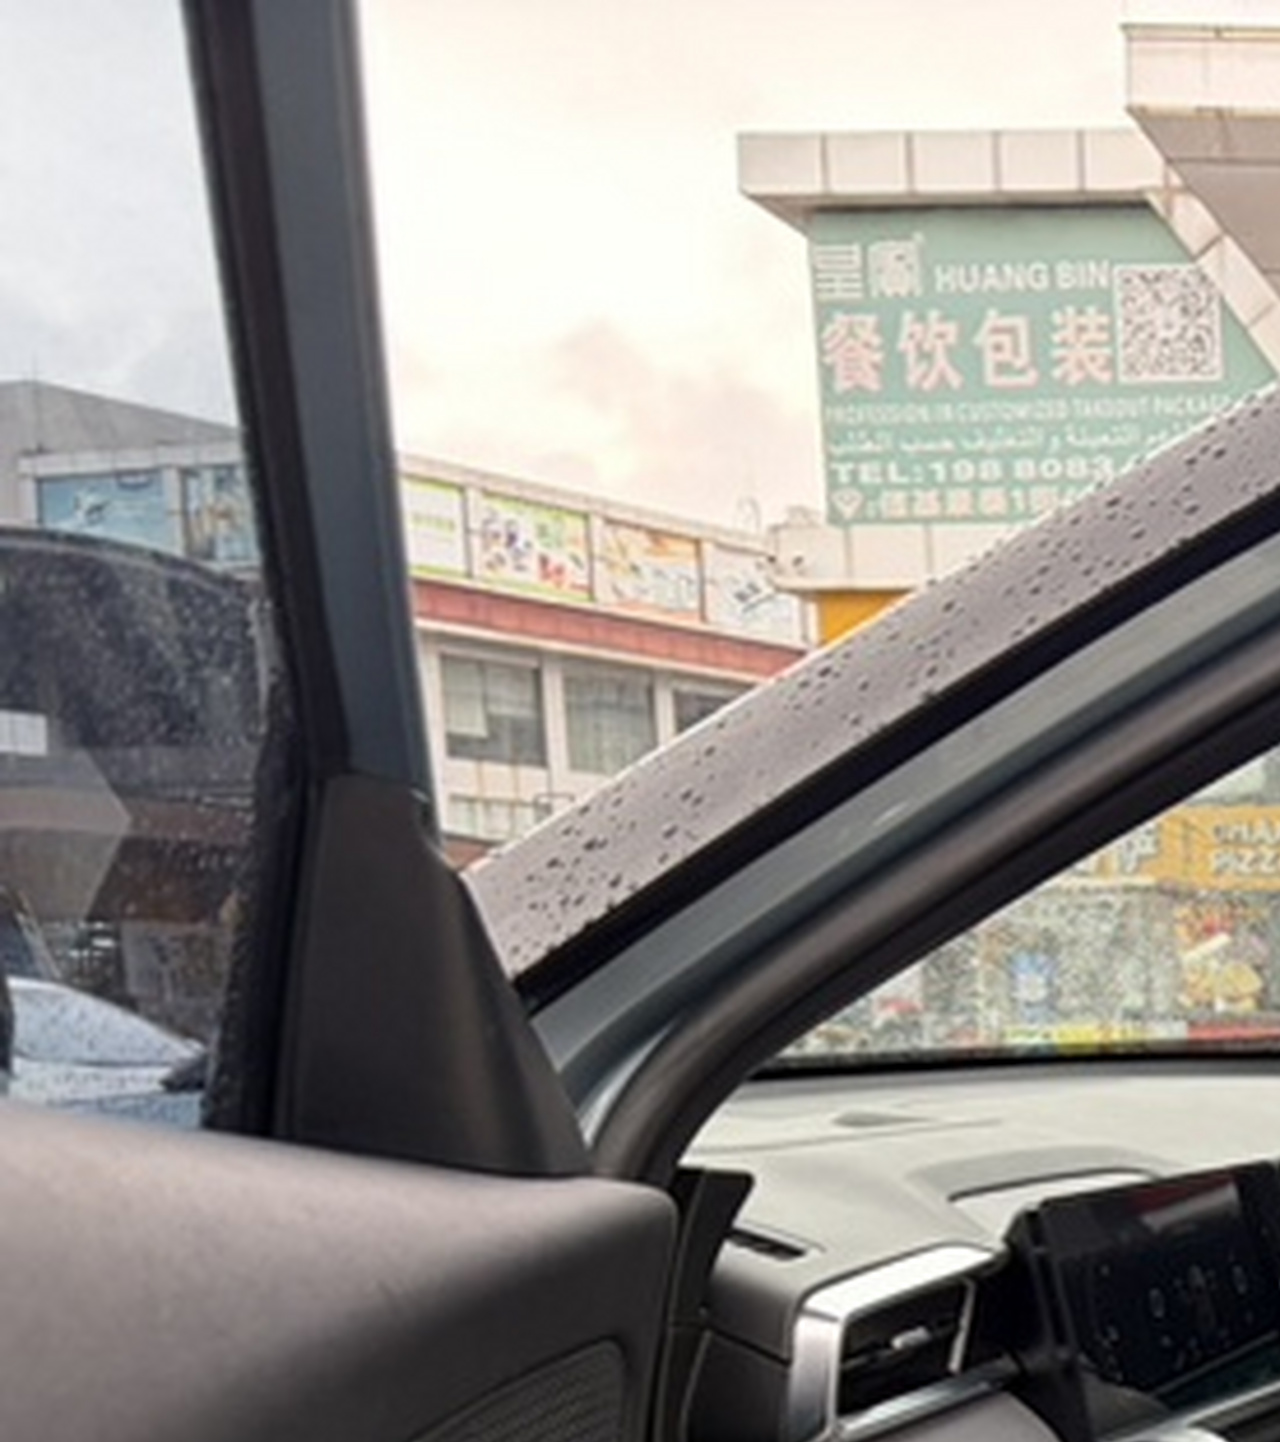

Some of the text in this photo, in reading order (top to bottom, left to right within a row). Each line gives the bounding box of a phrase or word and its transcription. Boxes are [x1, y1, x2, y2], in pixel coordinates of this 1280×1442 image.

[934, 259, 1111, 294] HUANG BIN
[822, 304, 1115, 393] 餐饮包装
